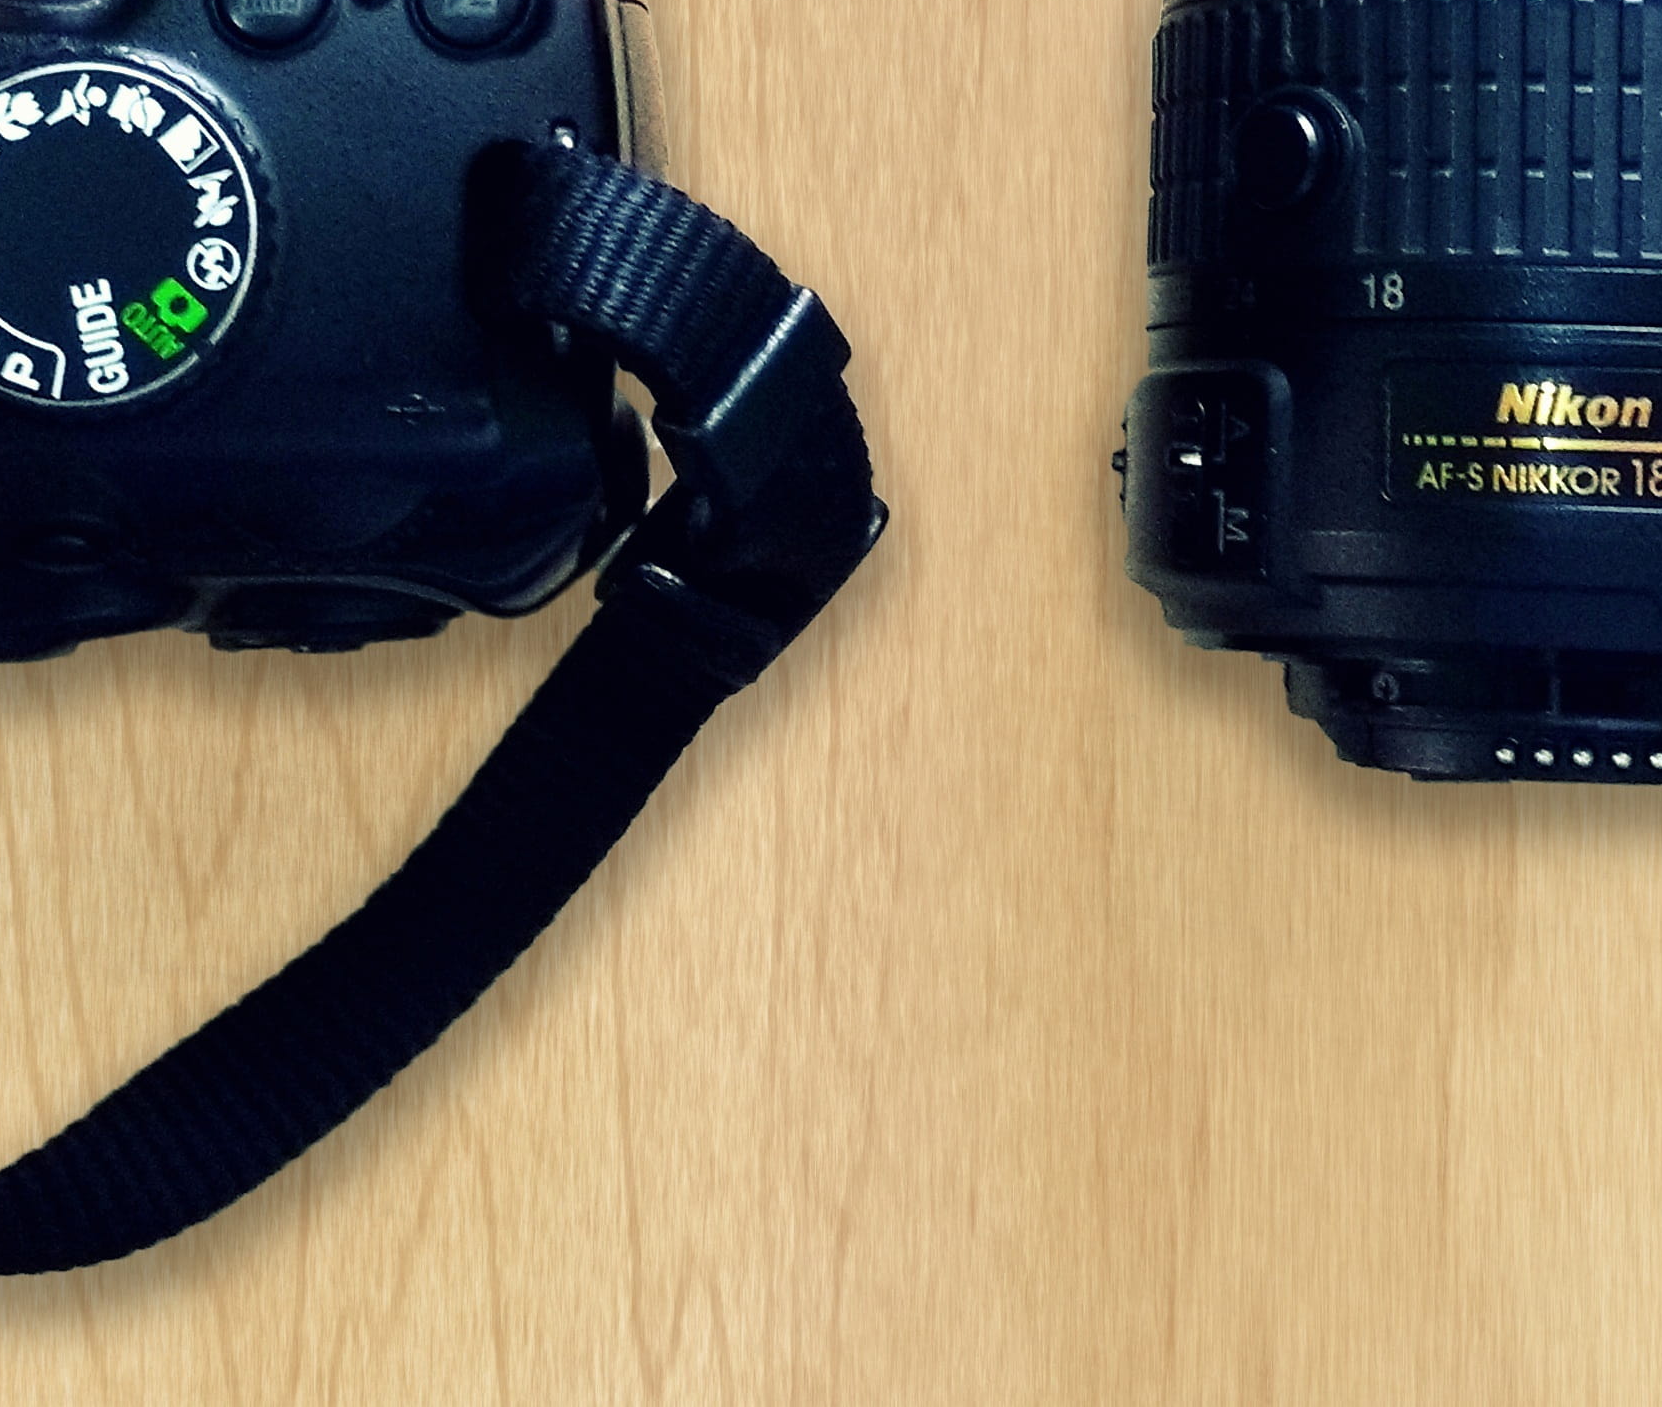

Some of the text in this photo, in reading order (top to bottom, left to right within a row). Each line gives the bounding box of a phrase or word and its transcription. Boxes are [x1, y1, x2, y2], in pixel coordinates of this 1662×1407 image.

[1360, 271, 1406, 312] 18
[69, 278, 130, 394] GUIDE
[1, 352, 41, 391] P
[1495, 381, 1653, 429] Nikon
[1416, 460, 1484, 492] AF-S
[1491, 463, 1622, 497] NIKKOR
